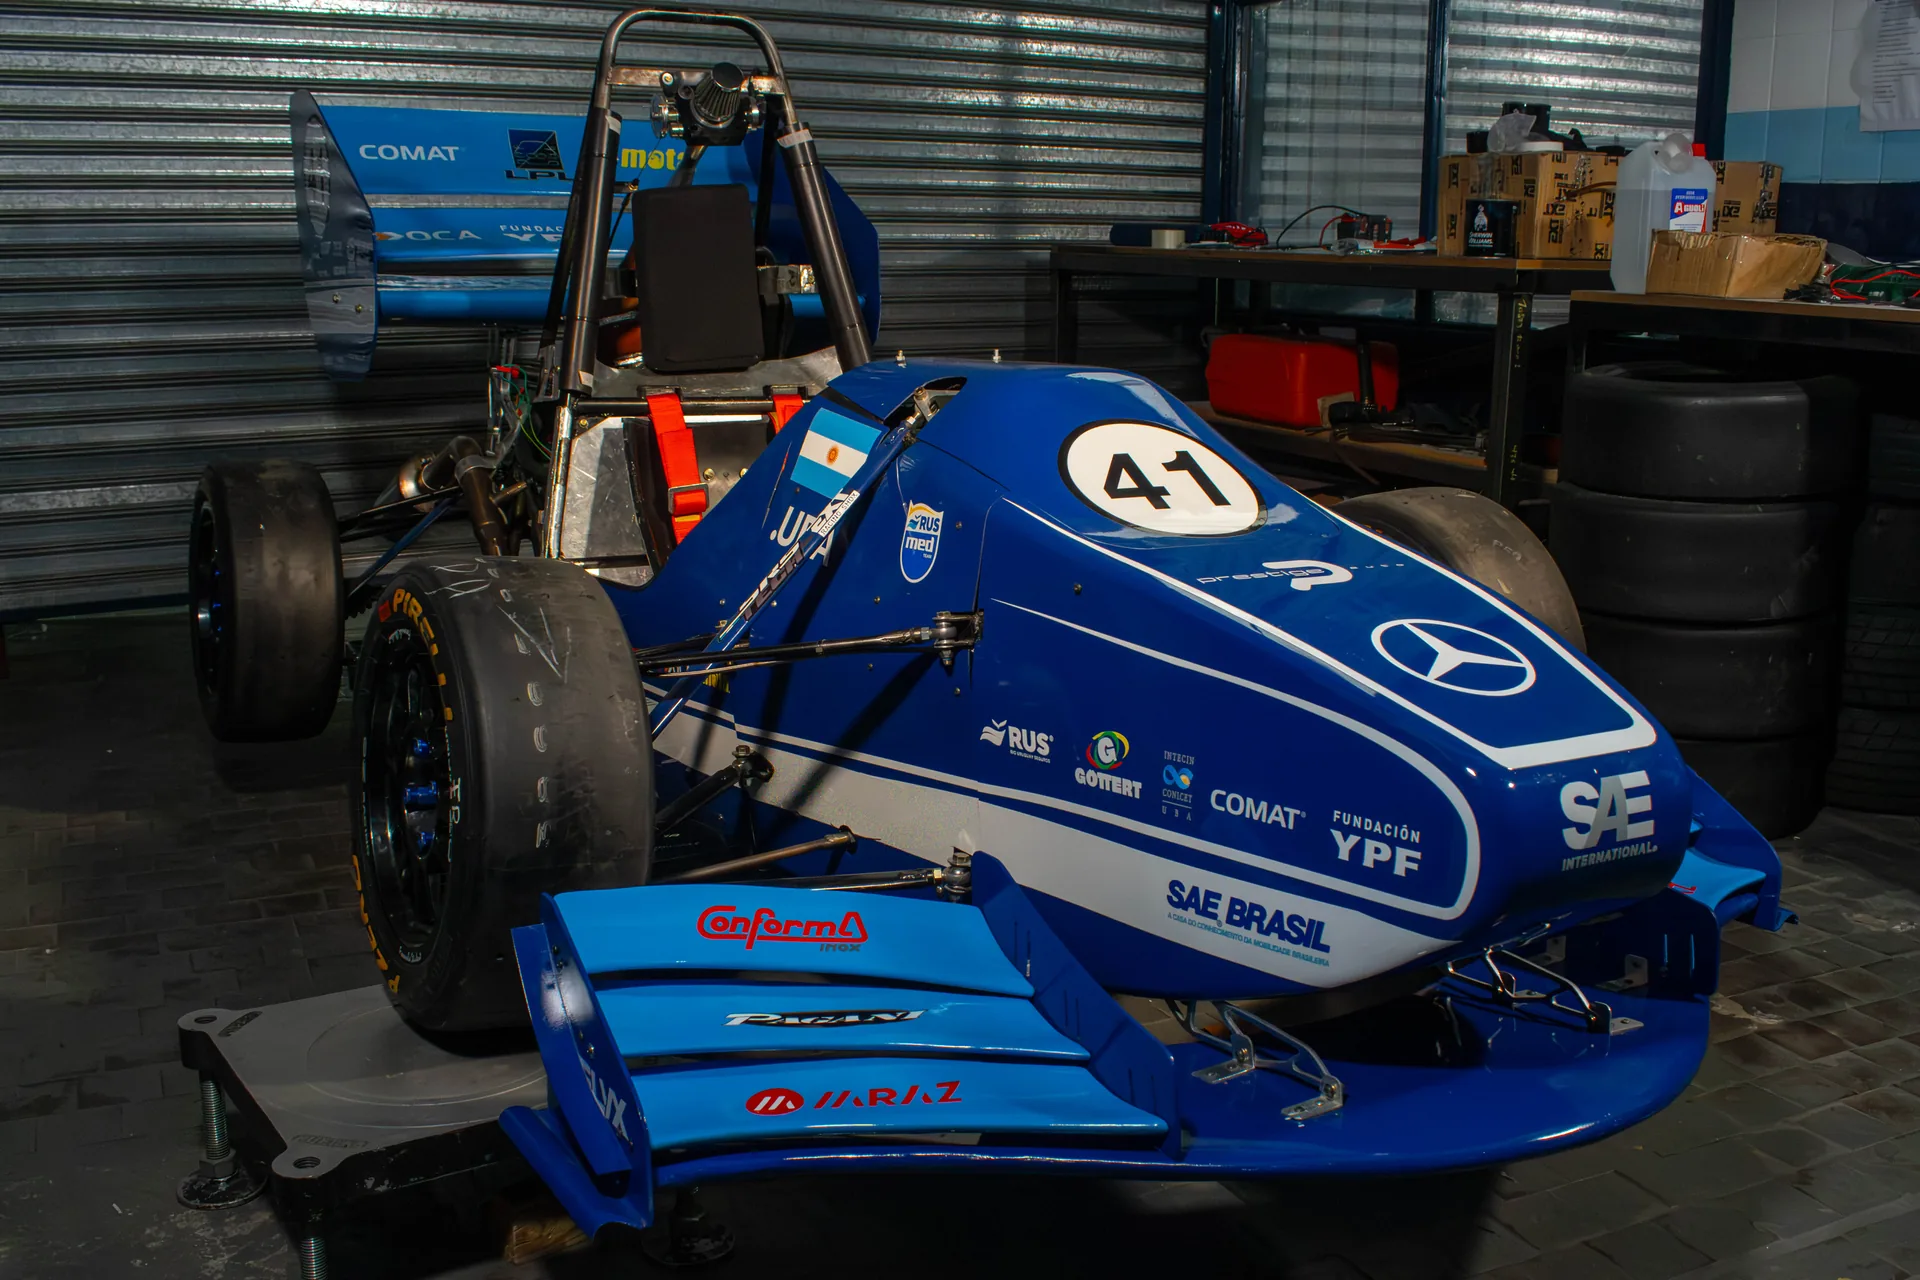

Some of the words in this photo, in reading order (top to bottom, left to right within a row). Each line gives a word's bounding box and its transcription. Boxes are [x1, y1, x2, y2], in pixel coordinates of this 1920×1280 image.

[359, 144, 459, 161] COMAT
[406, 229, 483, 241] OCA
[500, 224, 564, 233] FUNDAC
[1104, 451, 1232, 510] 41
[820, 510, 843, 536] RACING
[919, 515, 940, 532] RUS
[905, 536, 934, 553] med
[1197, 567, 1325, 584] prestige
[1008, 725, 1051, 756] RUS
[1164, 750, 1194, 765] INTECIN
[1162, 788, 1192, 803] CONICET
[1210, 789, 1301, 830] COMAT
[1559, 770, 1654, 850] SAE
[1333, 810, 1420, 843] FUNDACIÓN
[1329, 828, 1422, 877] YPF
[1561, 842, 1654, 871] INTERNATIONAL
[1166, 879, 1222, 921] SAE
[1225, 896, 1330, 953] BRASIL
[1173, 914, 1187, 924] CASA
[1188, 918, 1197, 927] DO
[1197, 921, 1243, 941] CONHECIMENTO
[1243, 936, 1252, 945] DA
